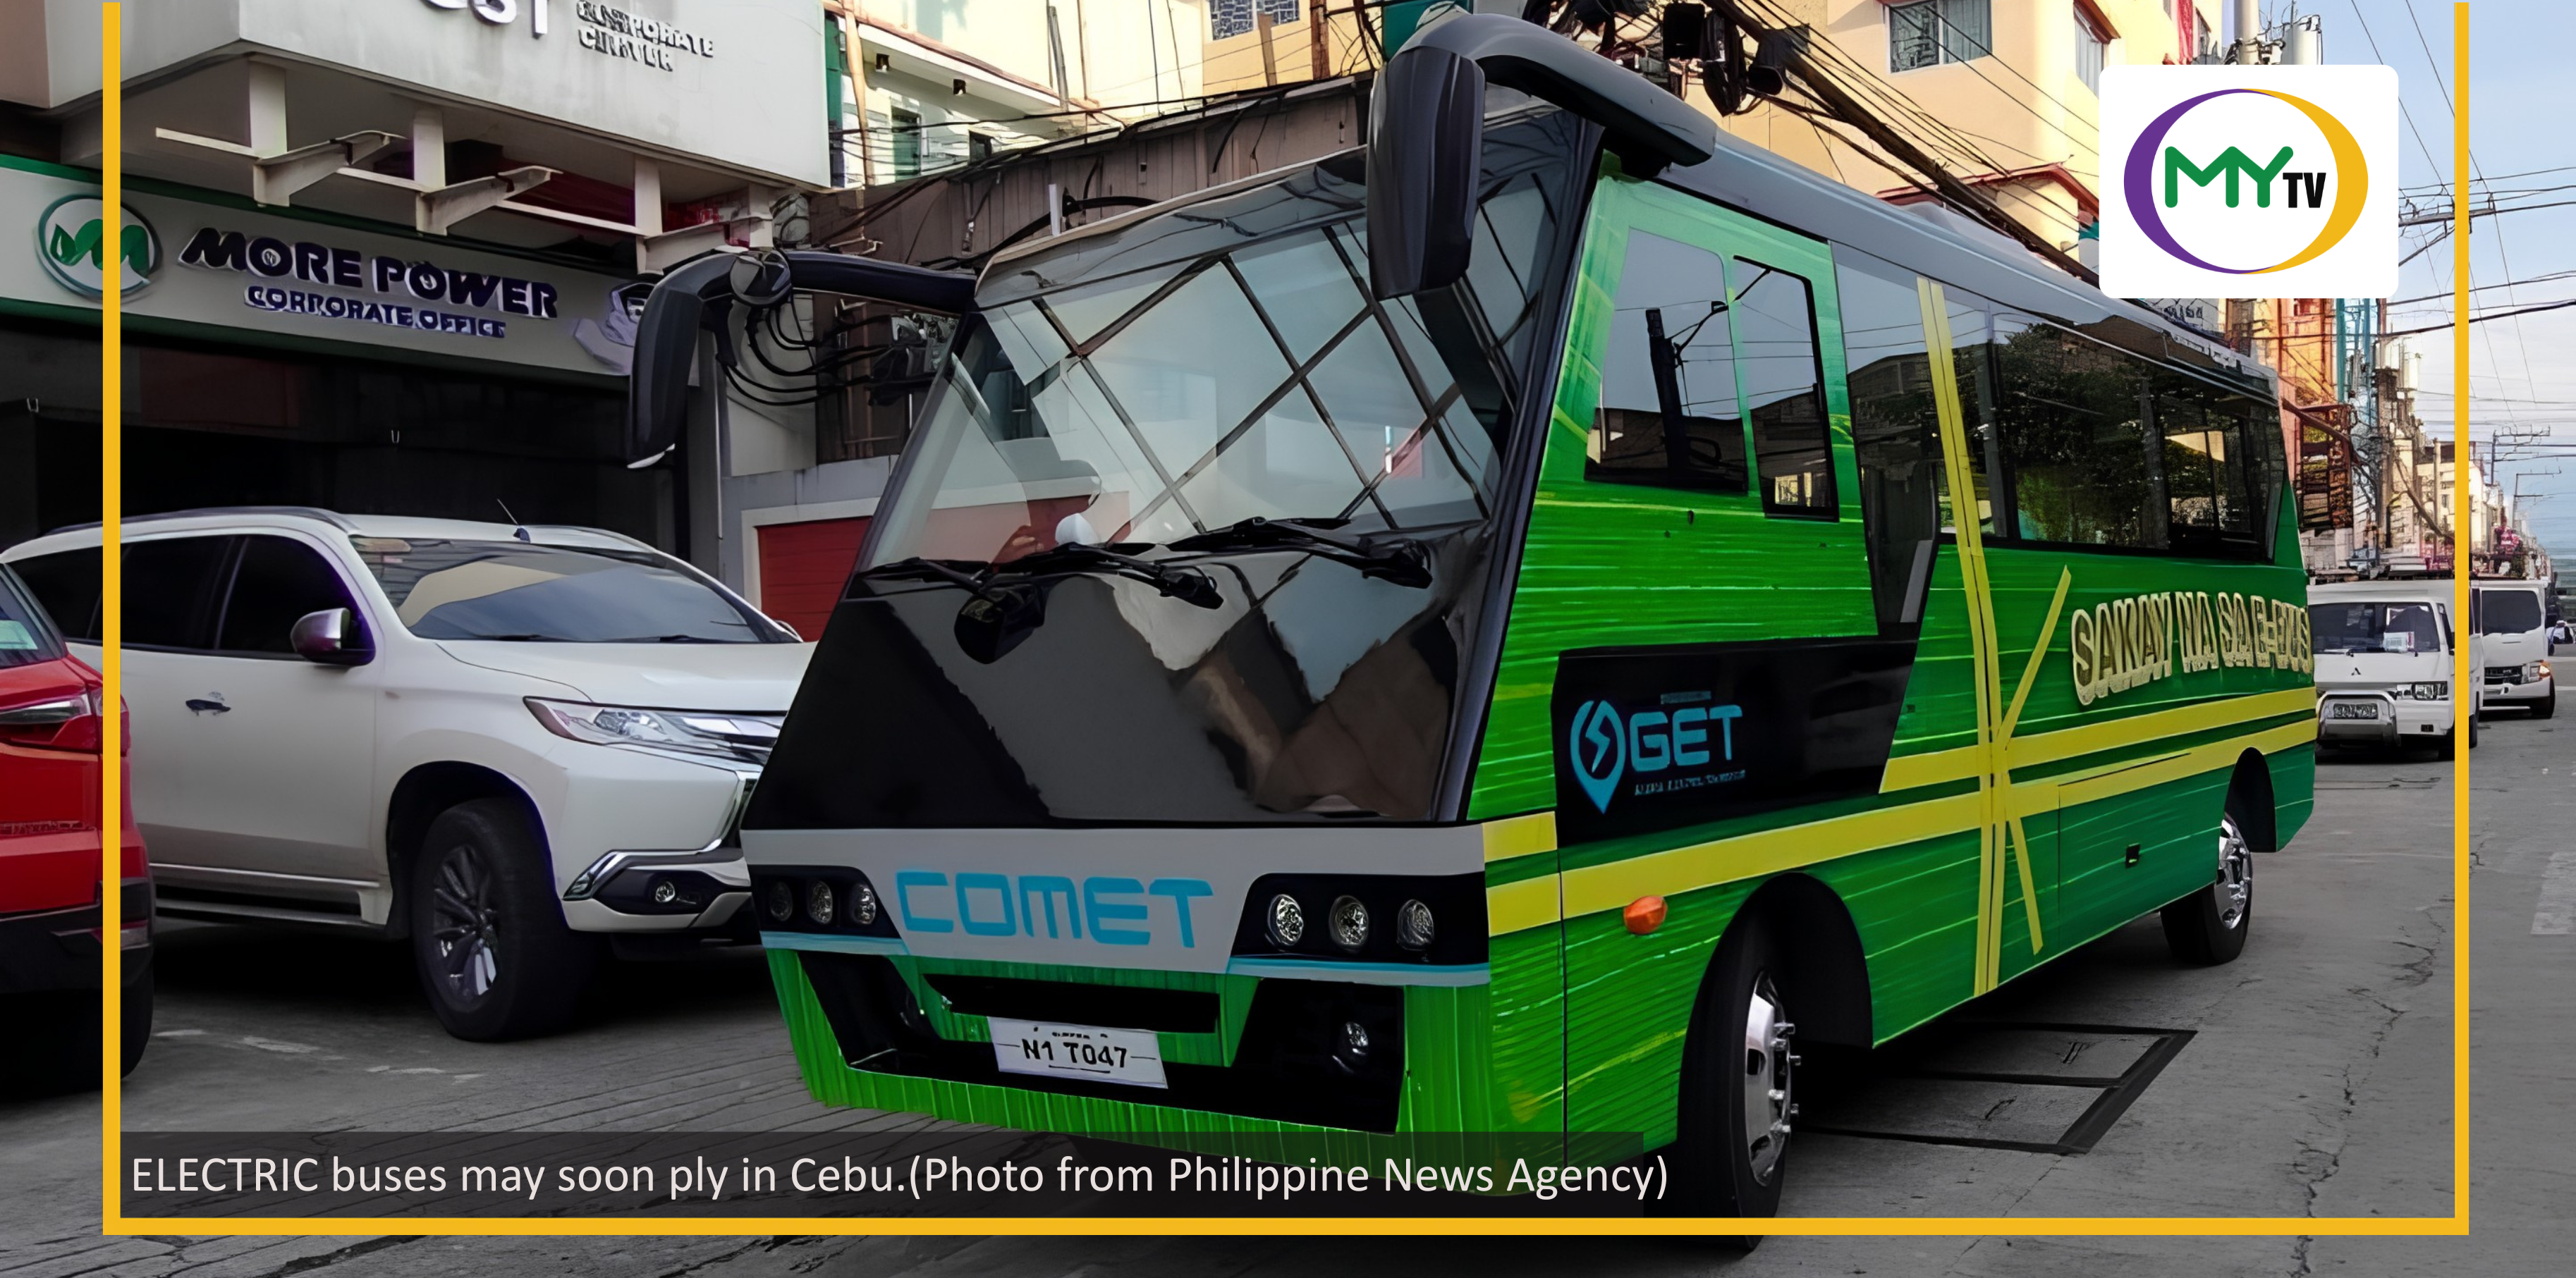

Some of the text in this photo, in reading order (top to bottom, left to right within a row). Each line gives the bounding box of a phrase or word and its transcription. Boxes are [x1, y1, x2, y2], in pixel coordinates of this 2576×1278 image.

[178, 226, 558, 319] MORE POWER
[1630, 704, 1742, 772] GET
[895, 871, 1214, 949] COMET
